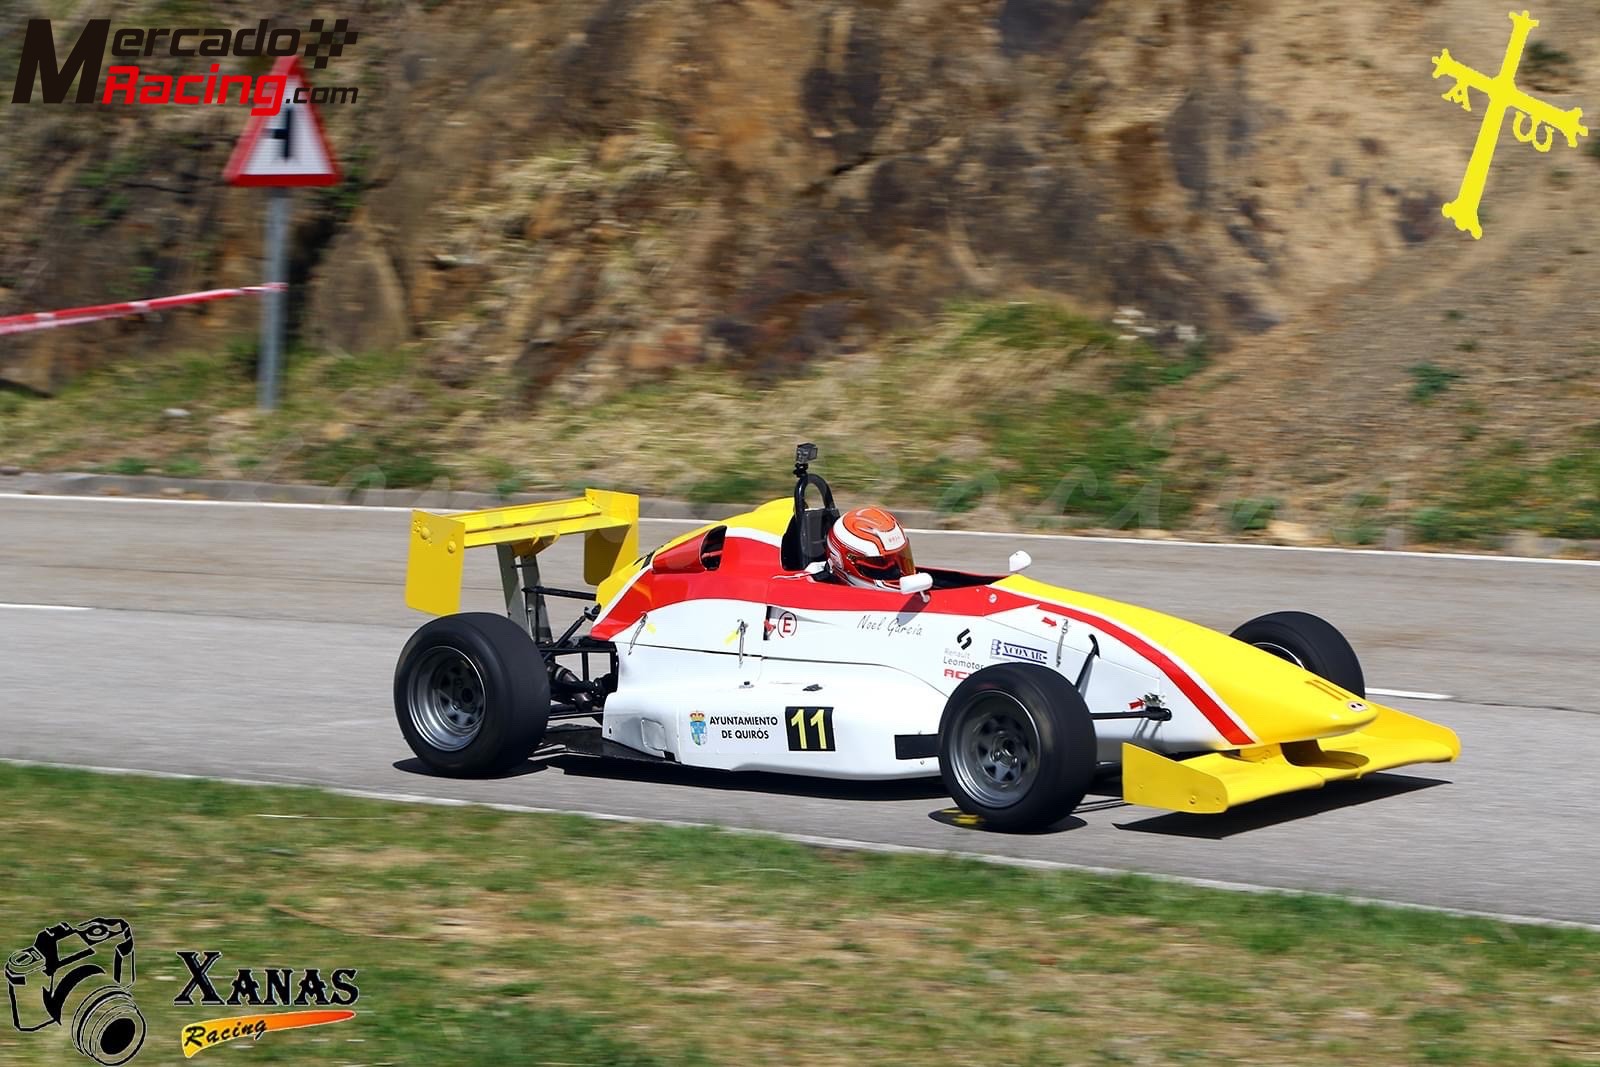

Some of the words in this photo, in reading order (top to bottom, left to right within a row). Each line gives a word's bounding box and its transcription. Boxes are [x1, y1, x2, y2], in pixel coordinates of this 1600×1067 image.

[783, 617, 792, 633] E
[857, 614, 886, 630] Noel
[709, 716, 778, 726] AYUNTAMIENTO
[791, 709, 827, 749] 11
[721, 730, 732, 739] DE
[735, 728, 769, 740] QUIRÓS
